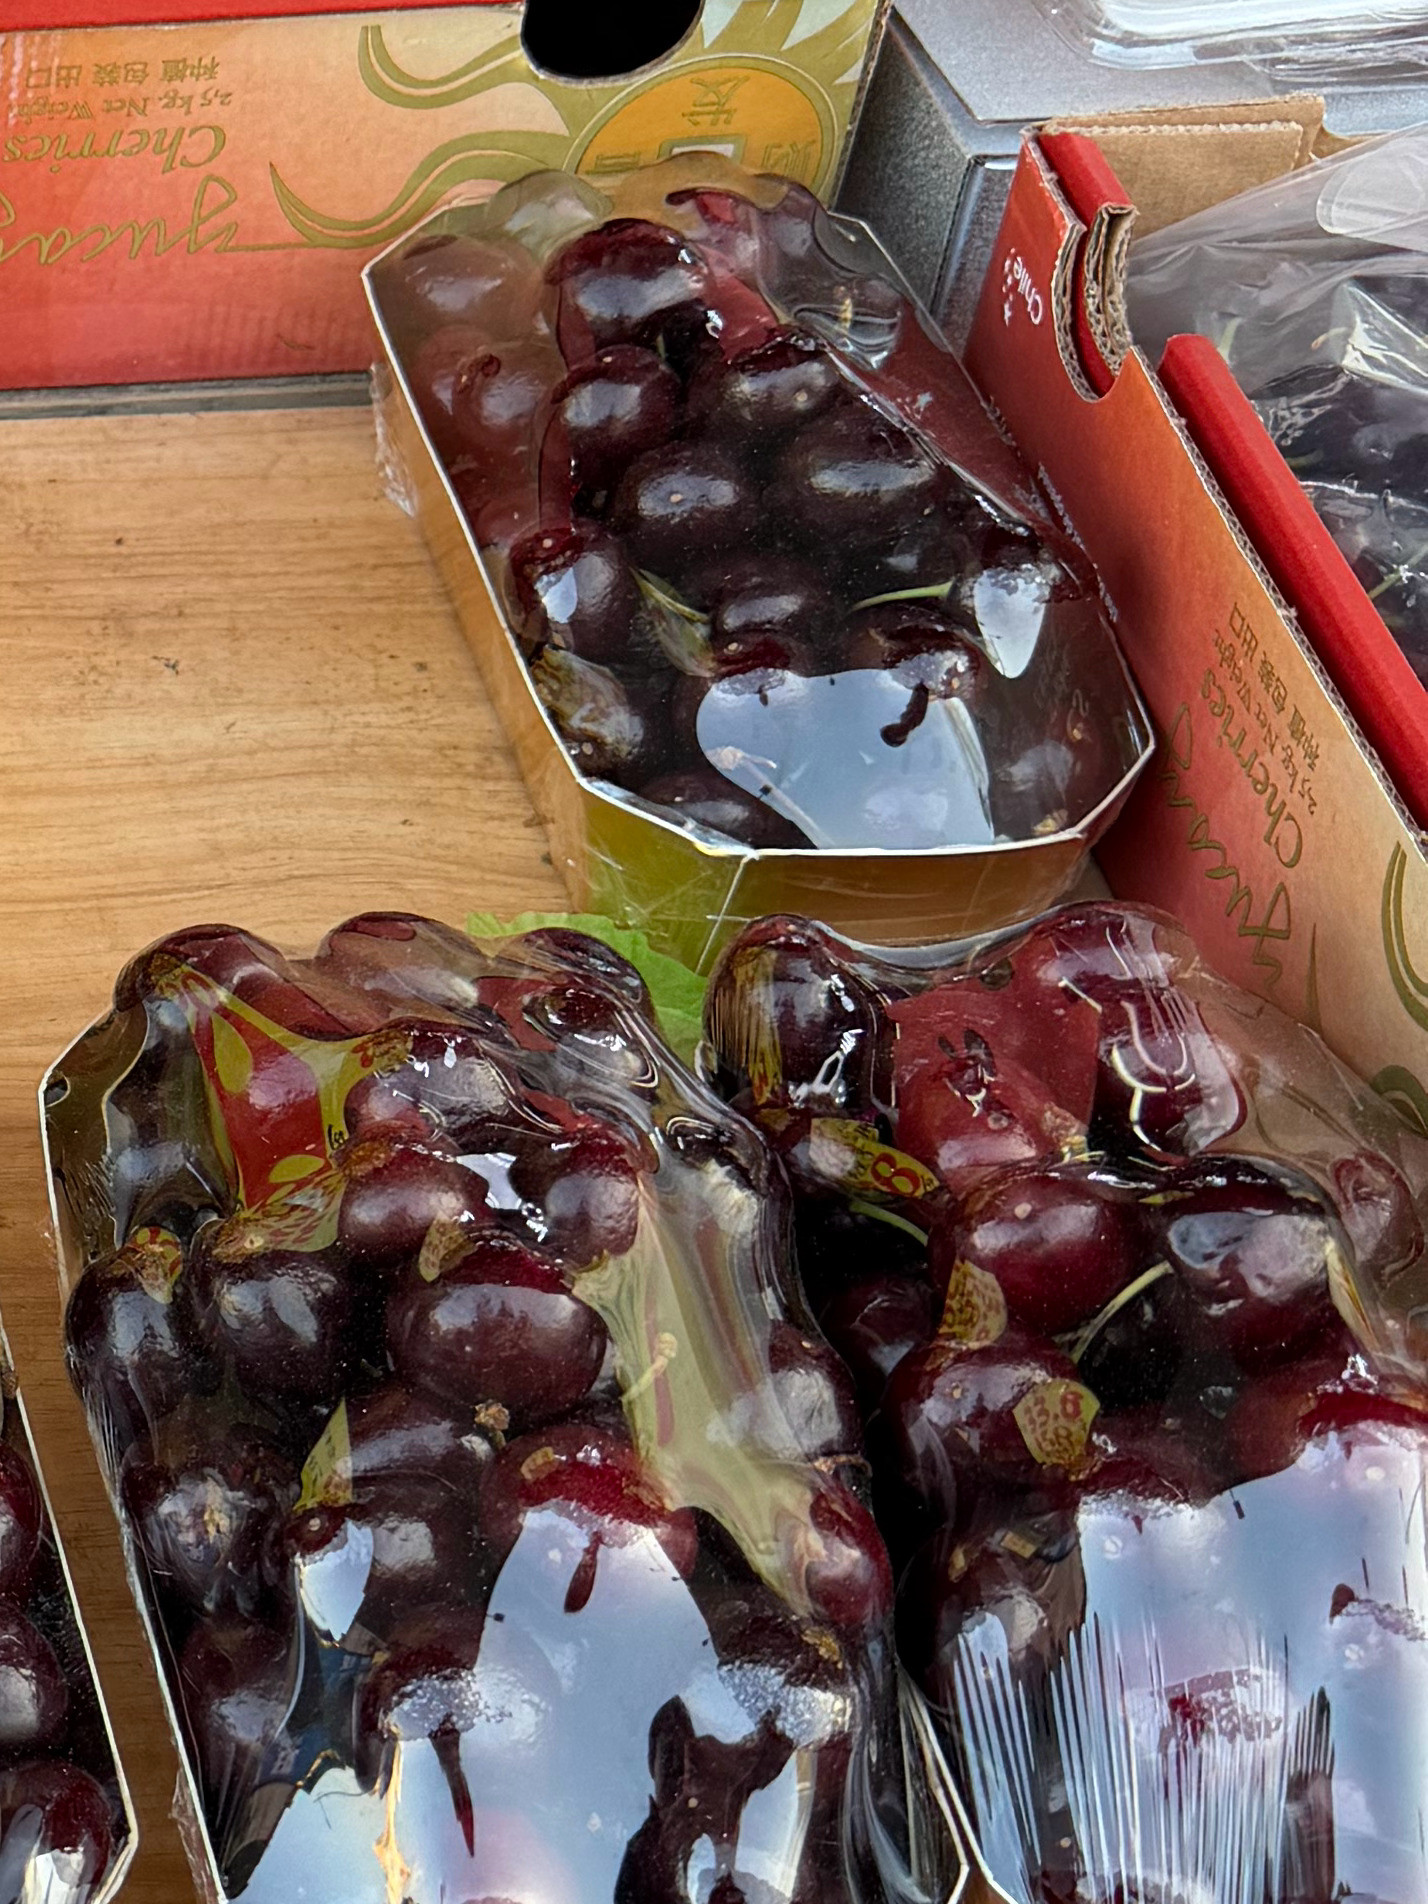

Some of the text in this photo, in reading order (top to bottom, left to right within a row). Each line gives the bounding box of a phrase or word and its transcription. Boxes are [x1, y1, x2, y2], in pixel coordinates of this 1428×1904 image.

[102, 97, 149, 118] Net
[2, 123, 228, 175] Cherries
[1013, 256, 1043, 325] Chile
[1200, 667, 1304, 869] Cherries
